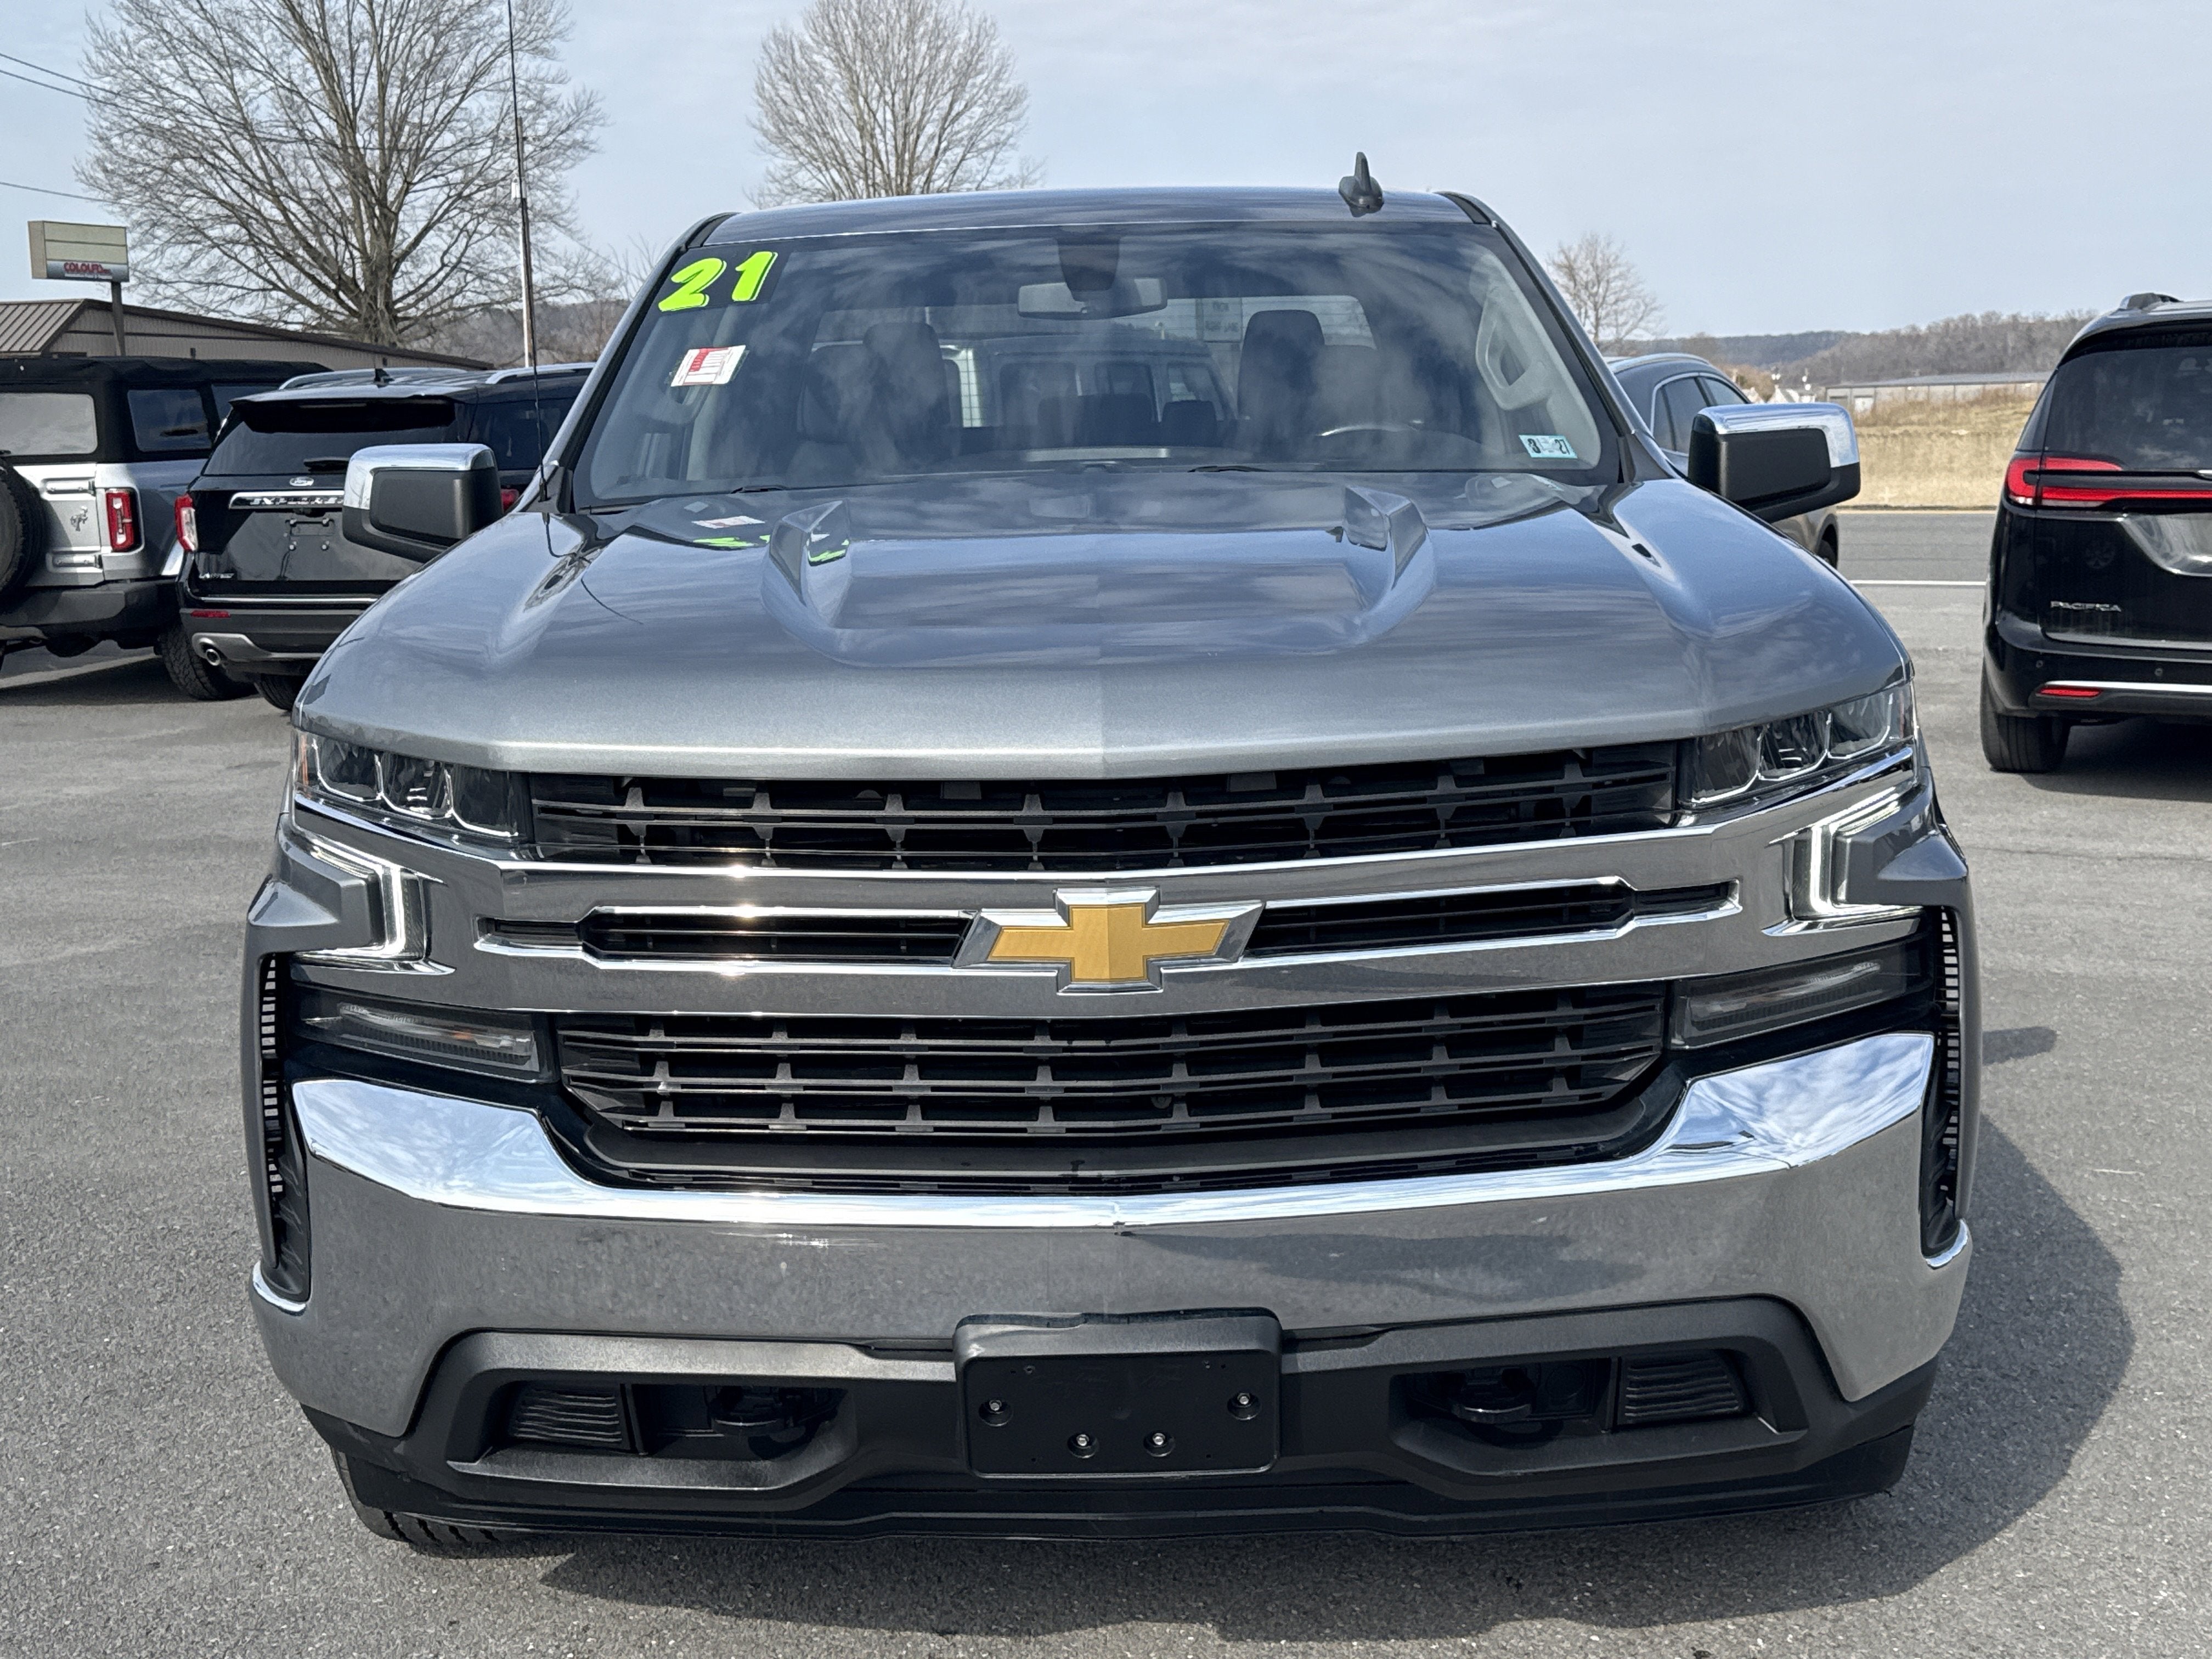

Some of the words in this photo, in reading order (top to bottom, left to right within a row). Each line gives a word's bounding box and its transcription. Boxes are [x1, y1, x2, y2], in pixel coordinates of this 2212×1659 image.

[658, 251, 778, 312] 21
[1527, 438, 1542, 454] 3
[1554, 438, 1571, 455] 27
[2050, 601, 2121, 612] PACIFICA
